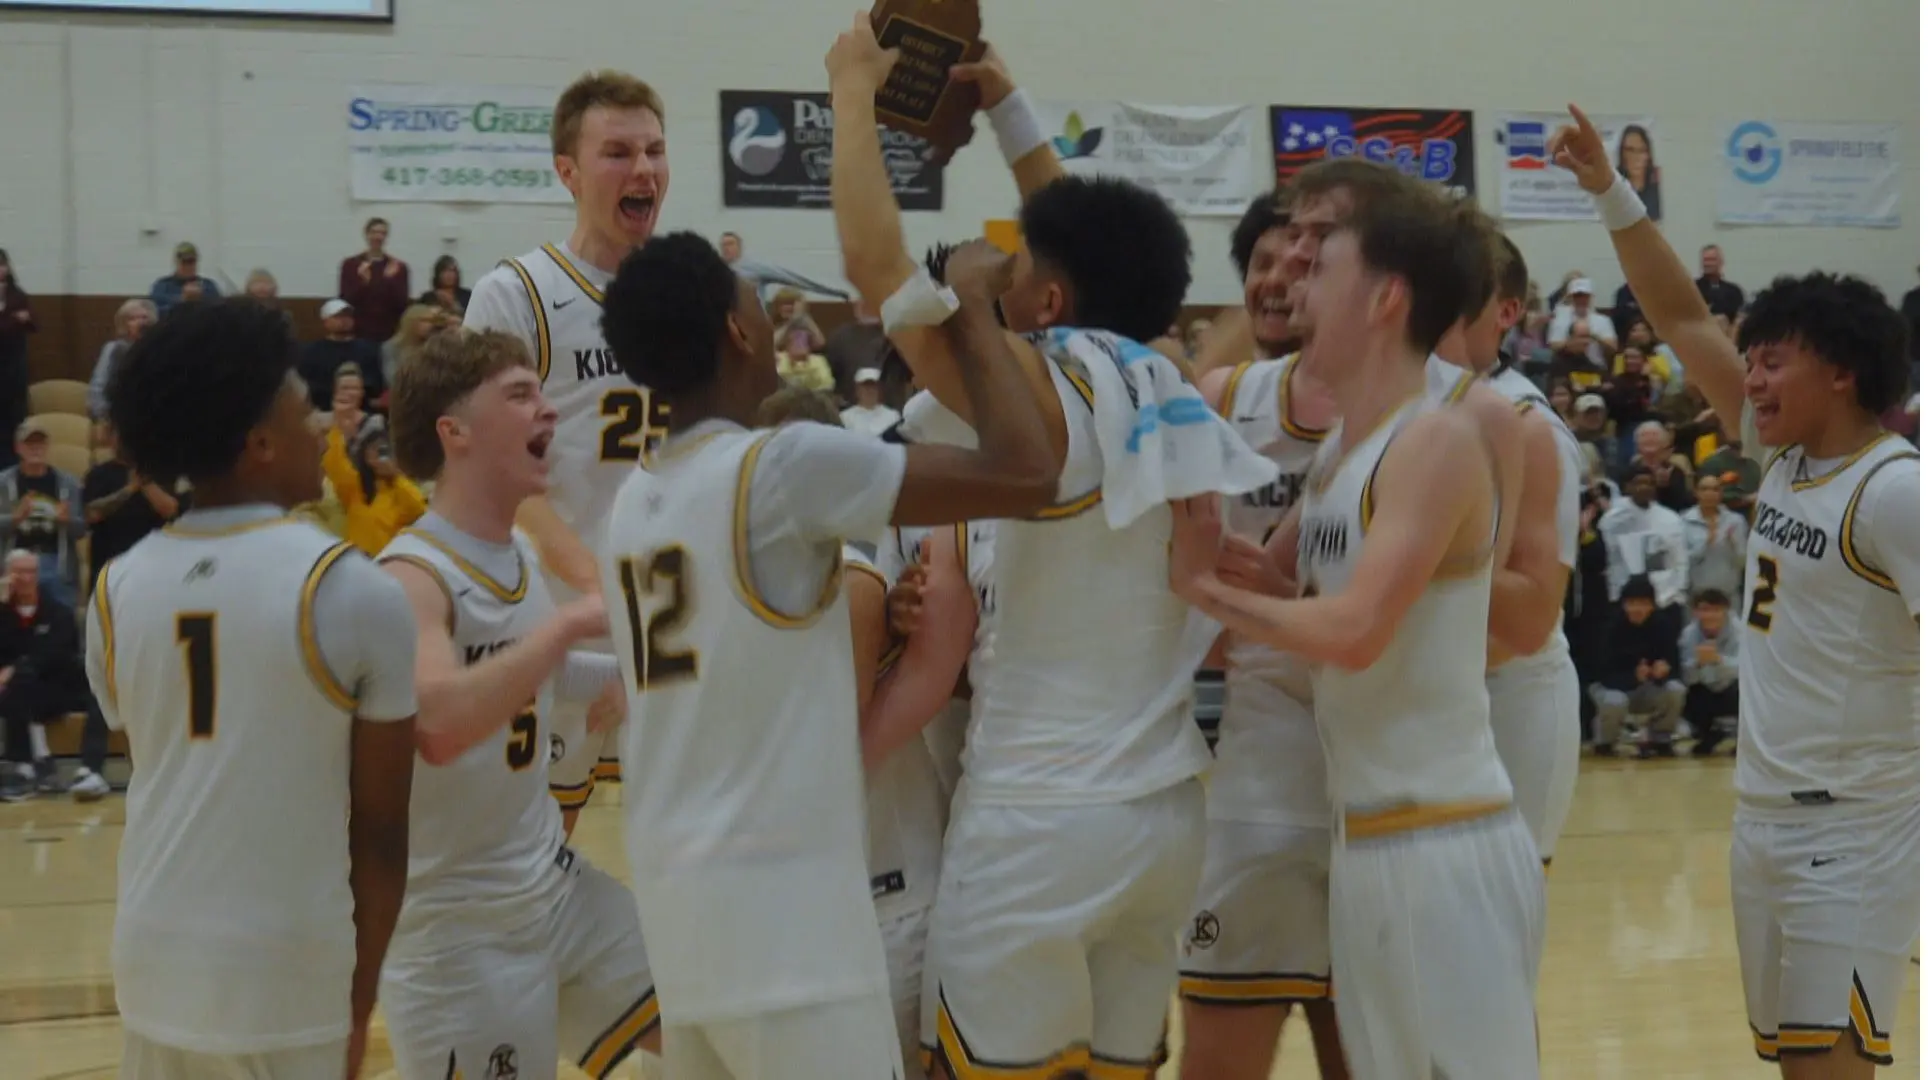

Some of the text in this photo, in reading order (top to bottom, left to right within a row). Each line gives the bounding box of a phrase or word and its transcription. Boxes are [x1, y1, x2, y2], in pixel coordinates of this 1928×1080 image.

[349, 97, 553, 133] SPRING-GREE
[793, 99, 833, 128] Pa
[381, 166, 553, 187] 417-368-0591
[598, 387, 671, 462] 25
[1753, 501, 1827, 560] ICKAPOO
[616, 543, 701, 693] 12
[1747, 552, 1781, 634] 2
[174, 611, 219, 741] 1
